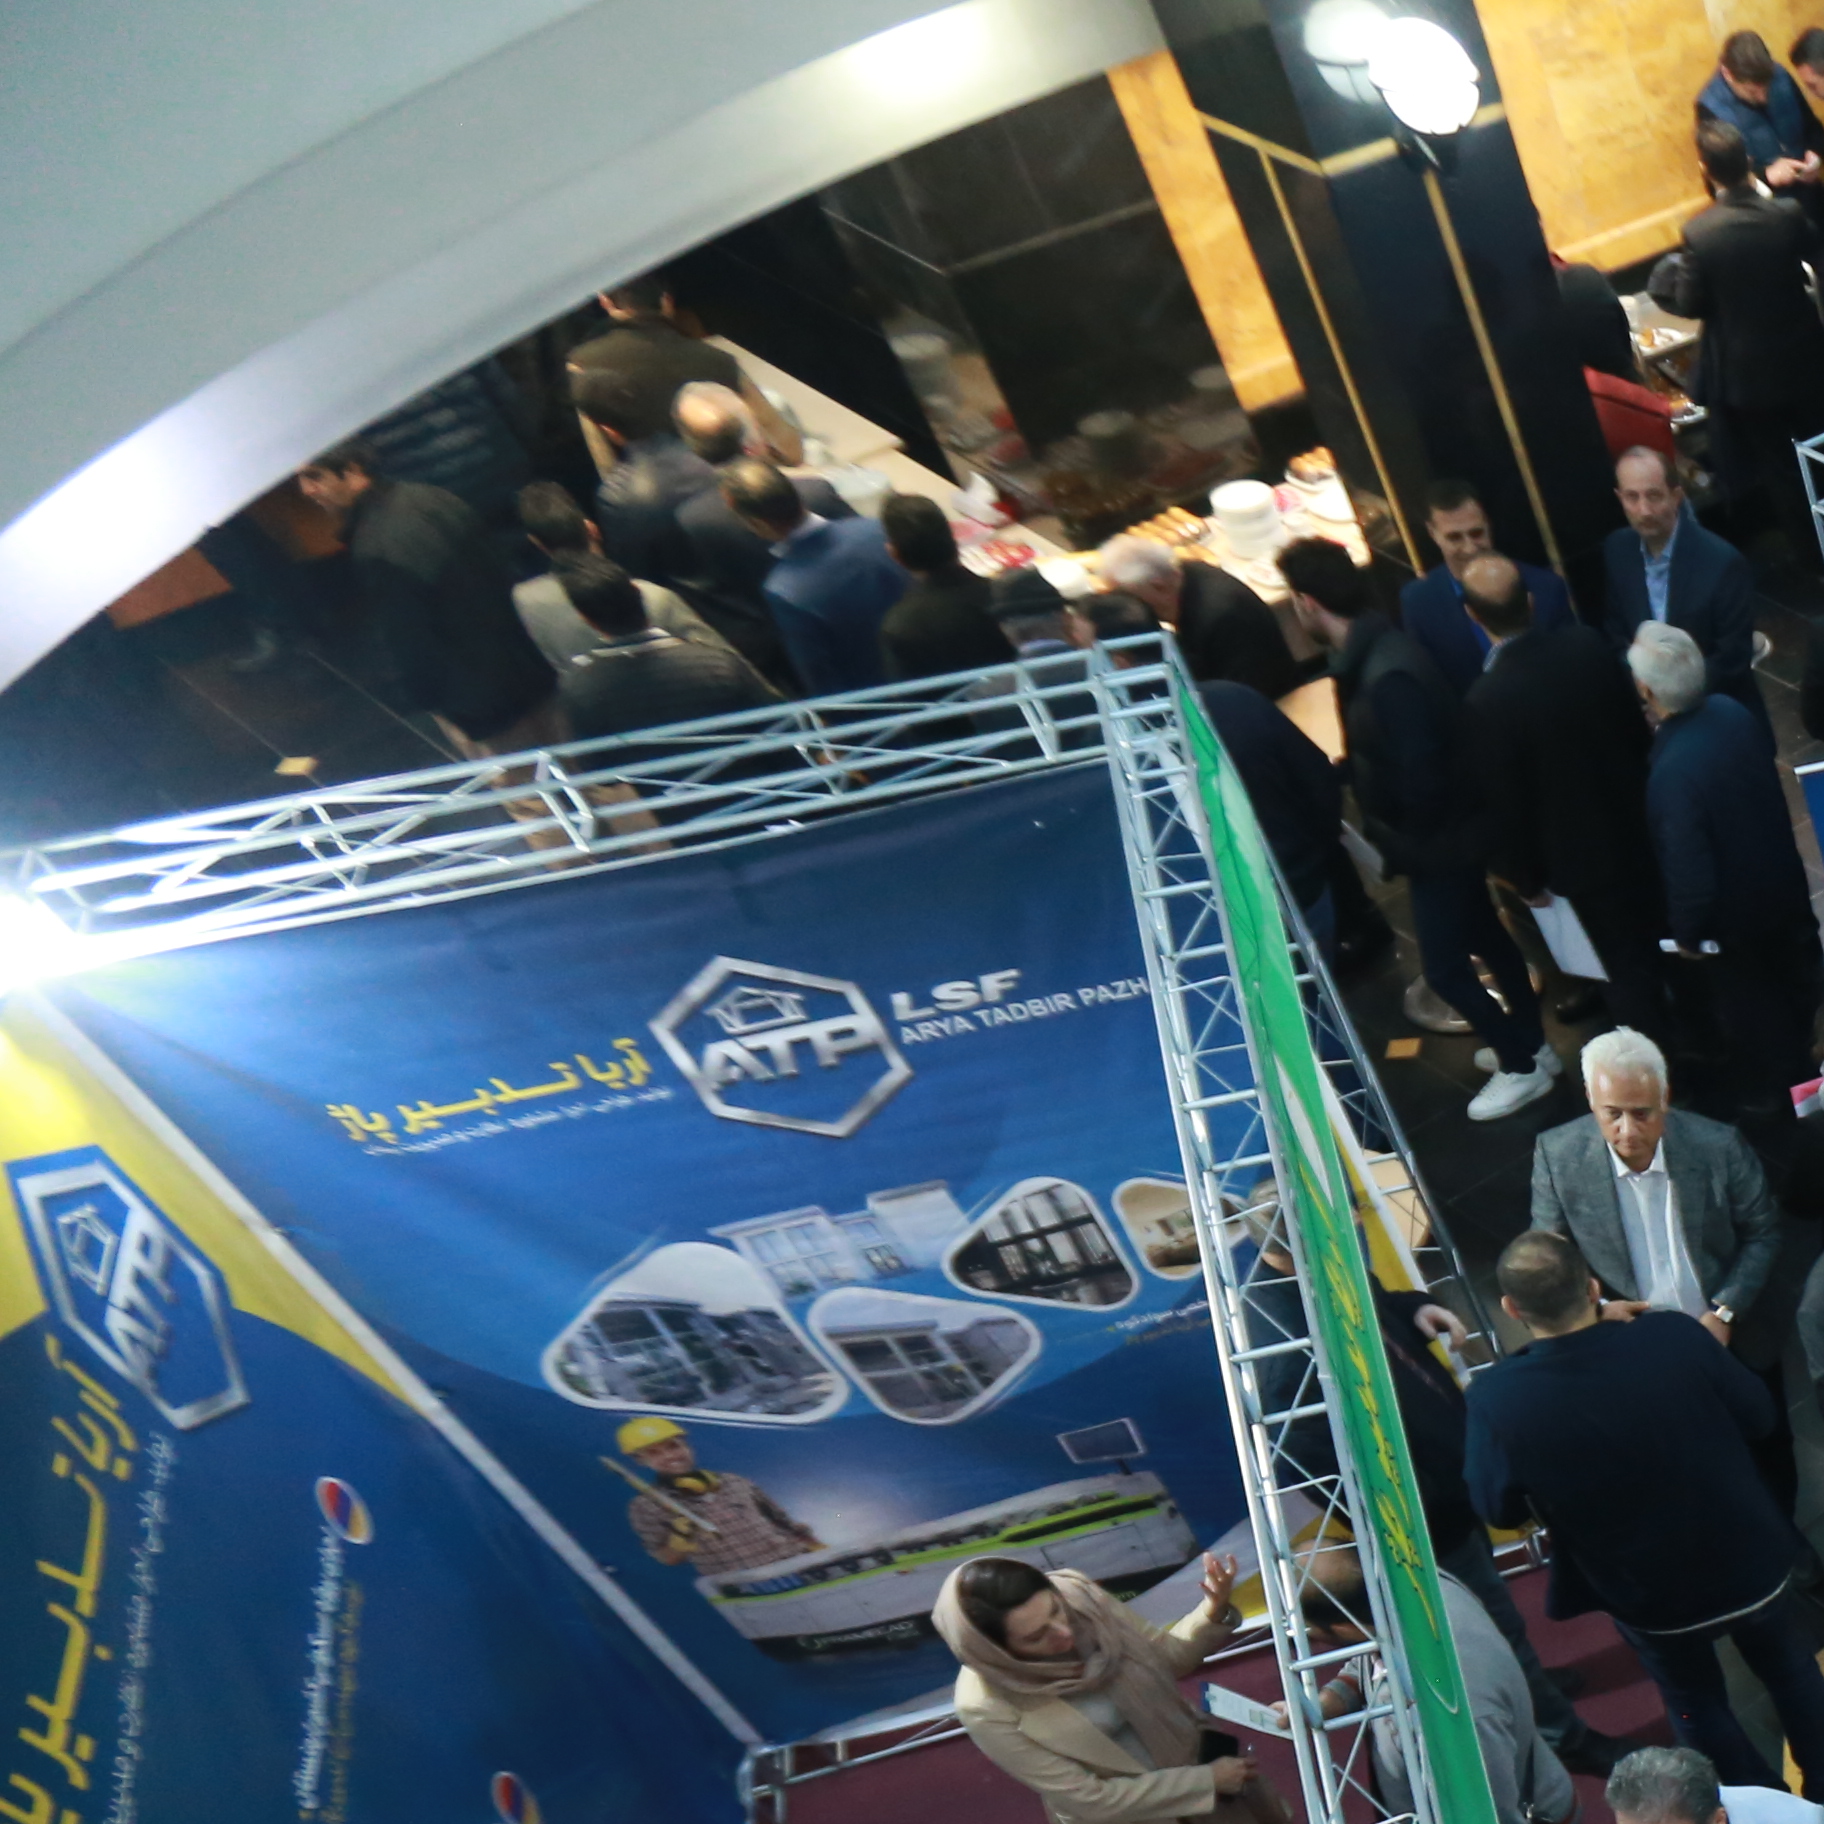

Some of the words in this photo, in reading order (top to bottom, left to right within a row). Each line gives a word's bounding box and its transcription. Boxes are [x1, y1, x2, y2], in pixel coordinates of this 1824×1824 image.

[891, 969, 1022, 1022] LSF
[899, 1007, 971, 1046] ARYA
[973, 991, 1072, 1029] TADBIR
[1076, 976, 1149, 1009] PAZH
[578, 1036, 652, 1086] آریا
[703, 1013, 882, 1091] ATP
[398, 1062, 578, 1134] تدبیر
[104, 1202, 173, 1395] ATP
